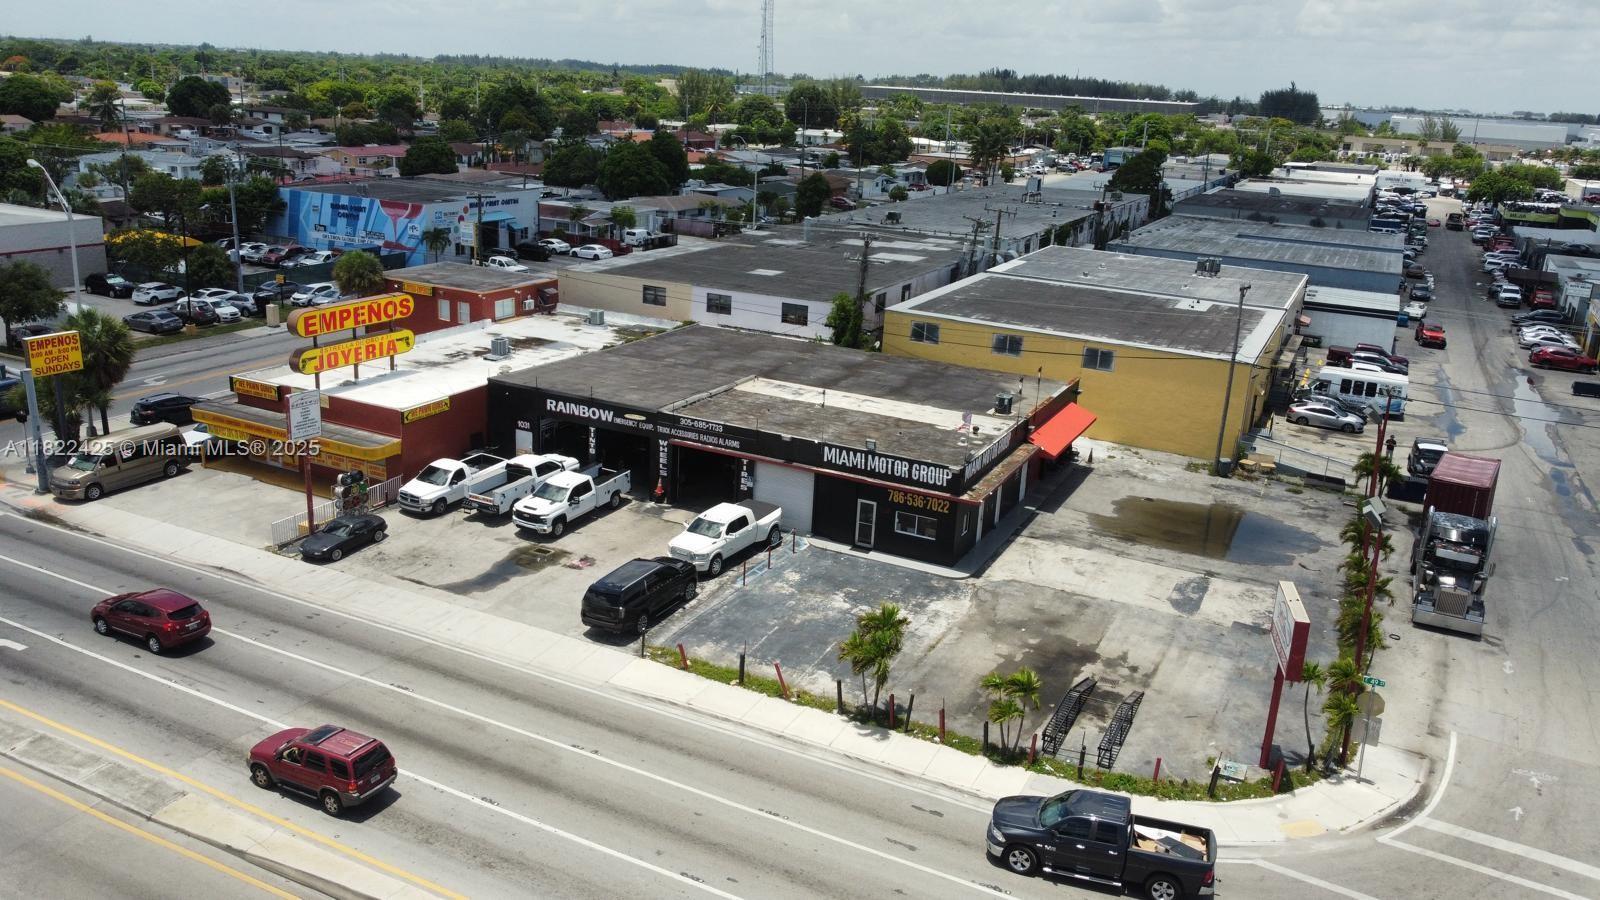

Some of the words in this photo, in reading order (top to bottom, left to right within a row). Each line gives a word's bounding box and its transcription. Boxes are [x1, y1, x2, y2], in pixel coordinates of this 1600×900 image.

[303, 298, 411, 336] EMPEÑOS
[44, 354, 69, 364] OPEN
[314, 338, 398, 371] JOYERIA
[35, 361, 81, 375] SUNDAYS
[546, 398, 614, 423] RAINBOW
[613, 417, 638, 428] EMERGENCY
[517, 420, 530, 429] 1031
[657, 425, 670, 434] TRUCK
[699, 433, 718, 444] RADIOS
[718, 438, 740, 449] ALARMS
[658, 439, 668, 477] WHEELS
[823, 446, 864, 470] MIAMI
[867, 454, 909, 478] MOTOR
[912, 463, 952, 487] GROUP
[739, 458, 749, 491] TIRES
